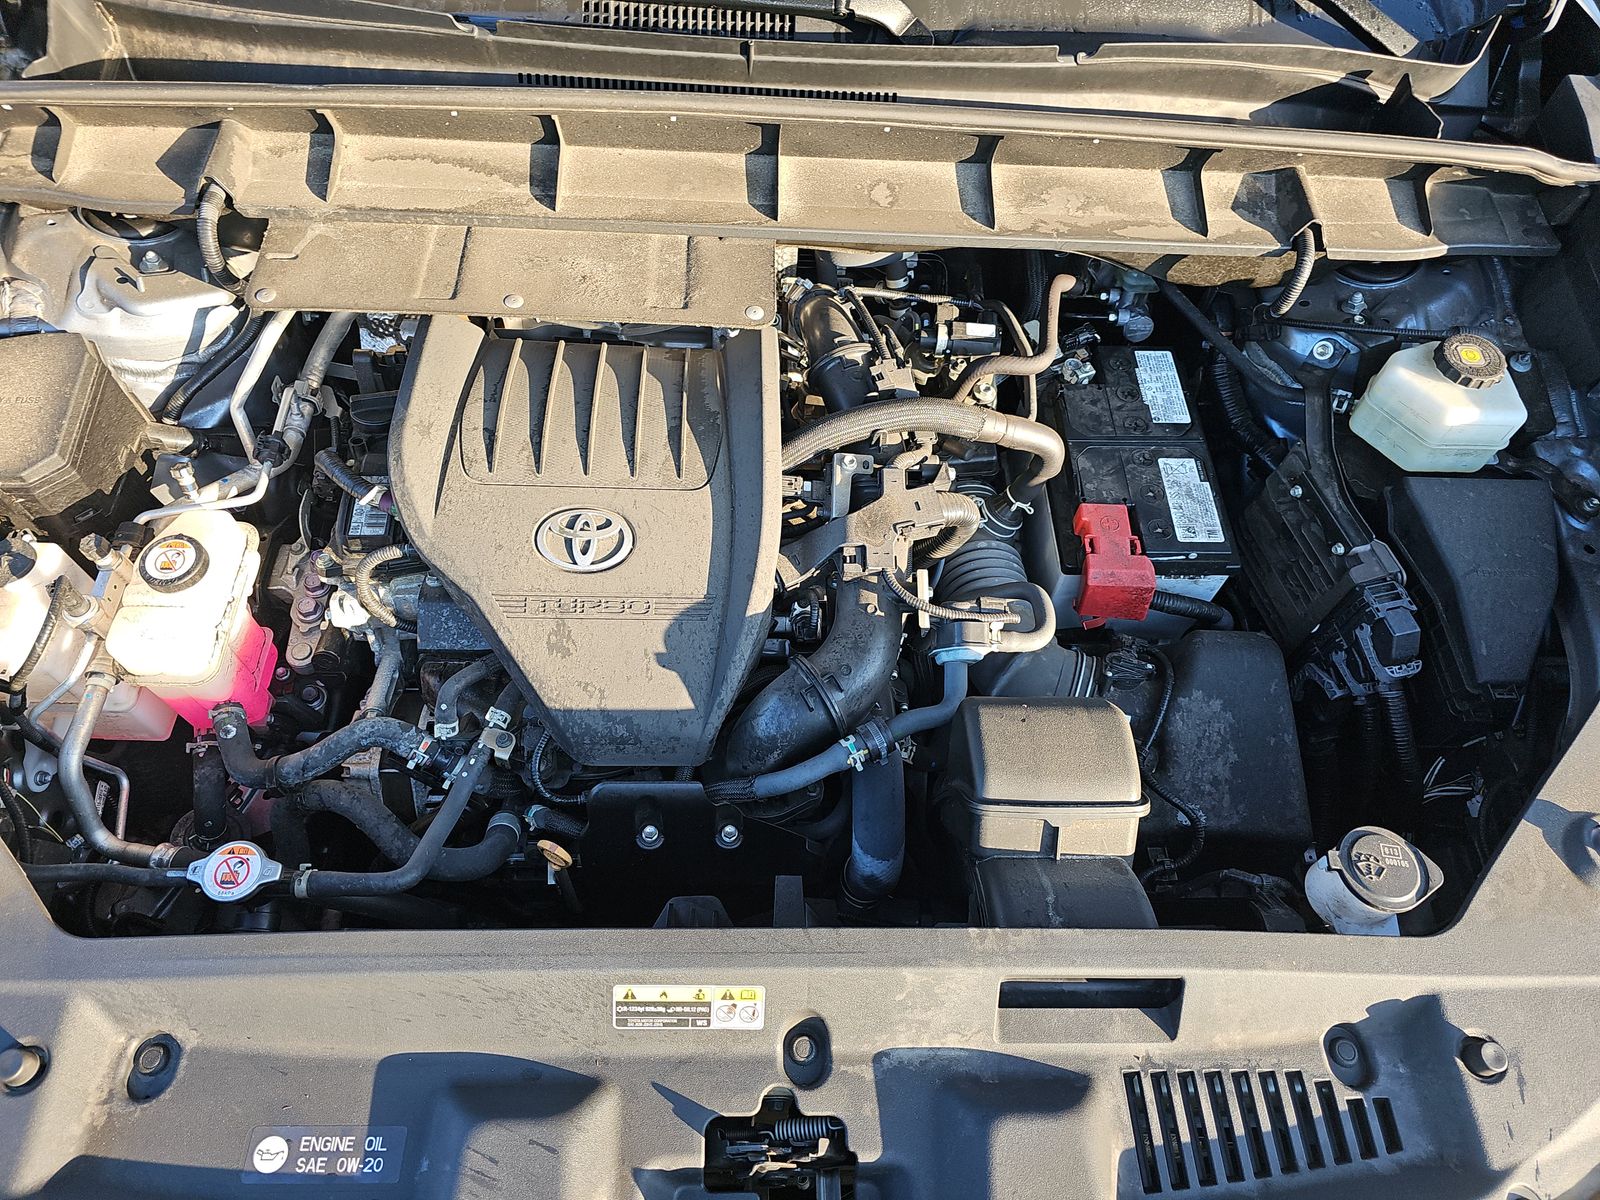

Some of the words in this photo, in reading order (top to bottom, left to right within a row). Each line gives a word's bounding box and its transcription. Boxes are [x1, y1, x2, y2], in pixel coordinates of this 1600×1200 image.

[530, 598, 651, 615] TURBO
[300, 1136, 356, 1152] ENGINE
[364, 1136, 387, 1152] OIL
[295, 1157, 328, 1173] SAE
[336, 1157, 384, 1173] 0W-20
